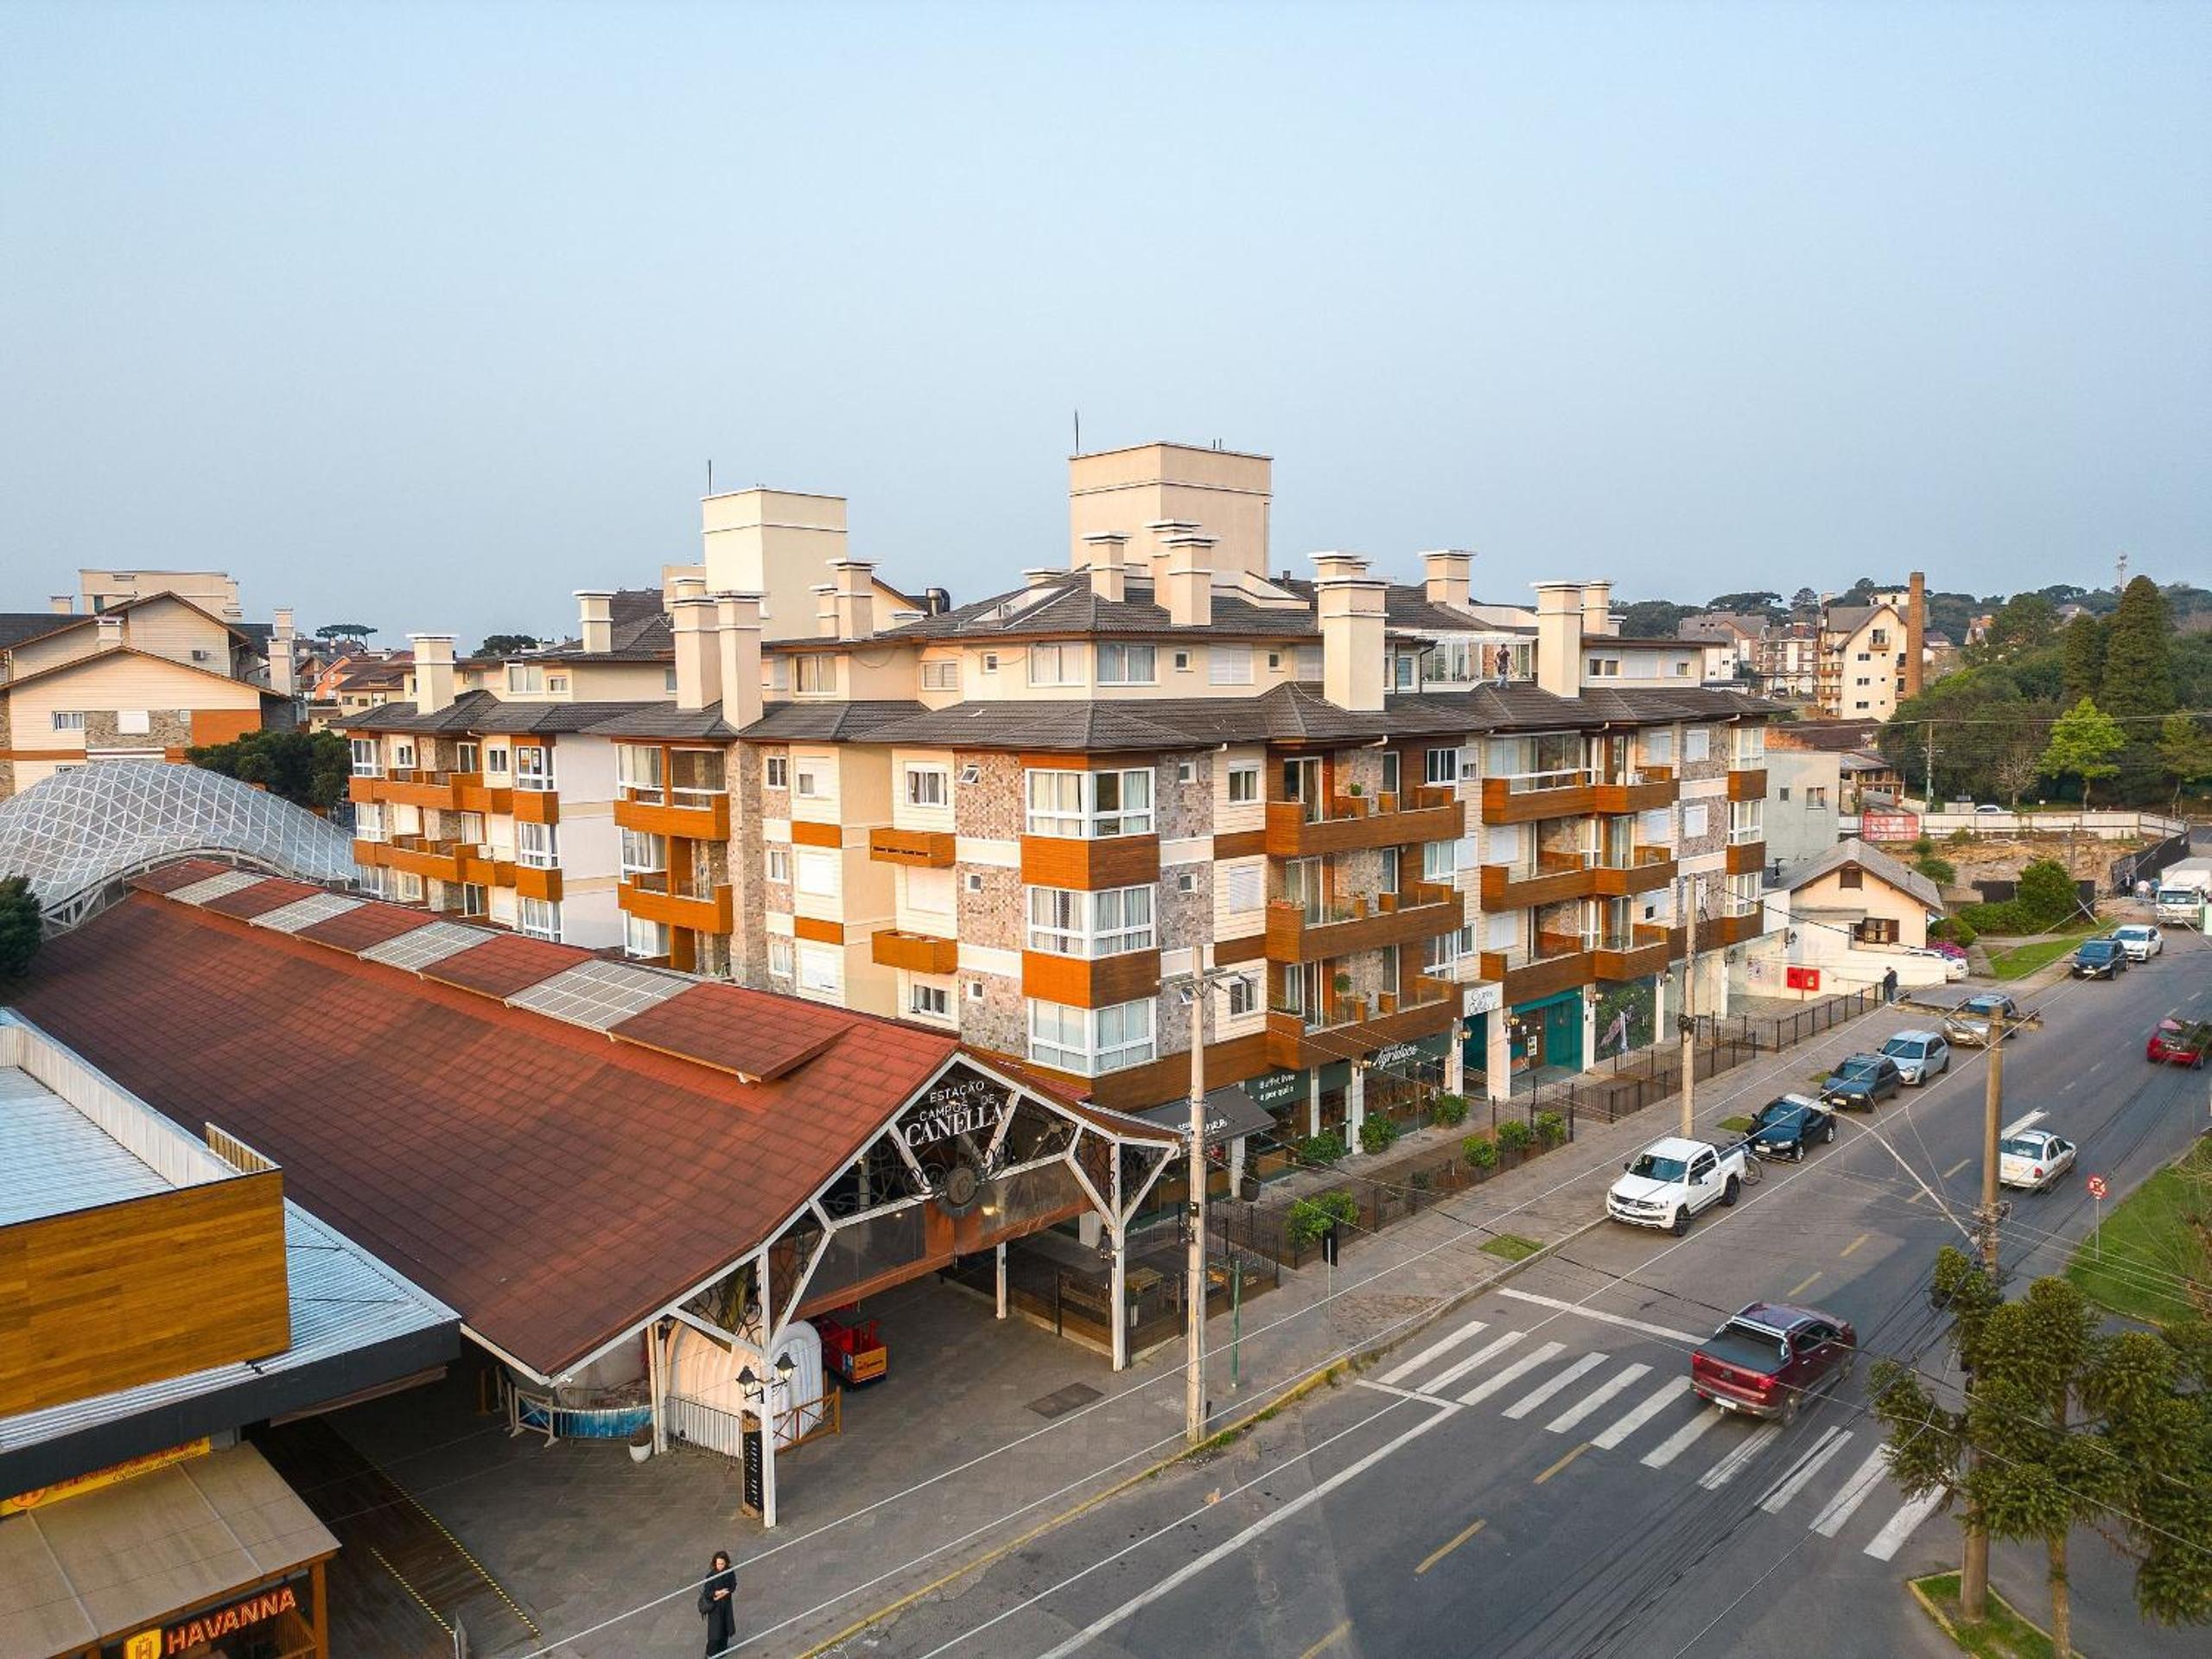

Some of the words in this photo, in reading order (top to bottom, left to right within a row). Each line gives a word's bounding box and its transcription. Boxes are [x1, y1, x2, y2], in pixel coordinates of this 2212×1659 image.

[919, 1100, 969, 1122] CAMPOS
[981, 1093, 995, 1106] DE
[930, 1080, 985, 1103] ESTAÇÃO
[905, 1102, 1004, 1147] CANELLA
[167, 1586, 296, 1655] HAVANNA
